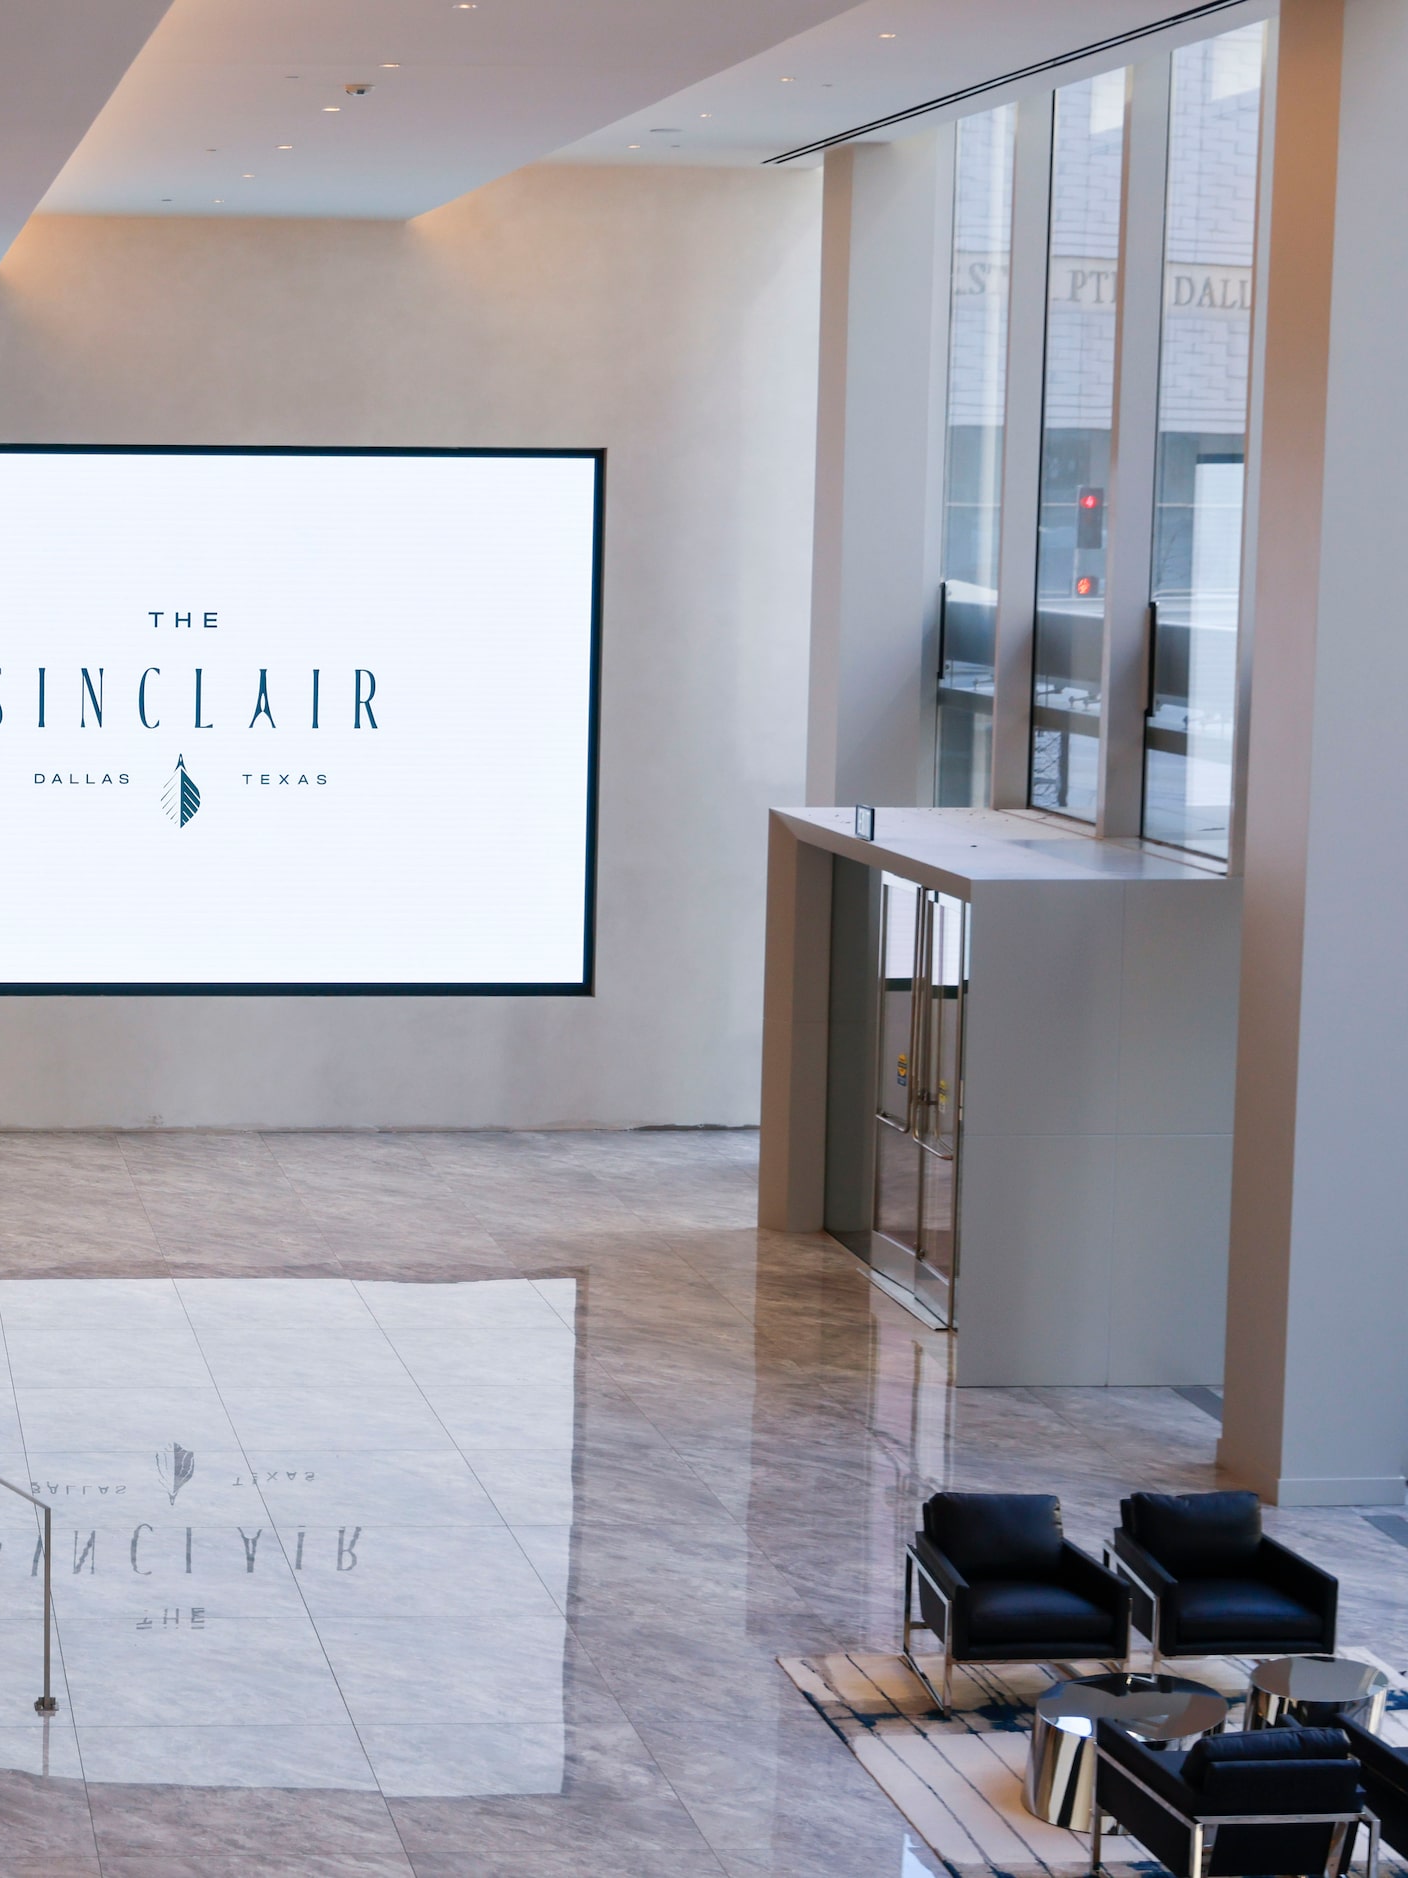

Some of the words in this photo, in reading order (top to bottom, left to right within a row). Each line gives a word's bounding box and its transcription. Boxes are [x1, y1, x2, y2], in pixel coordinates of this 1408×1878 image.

[148, 611, 219, 629] THE
[34, 773, 131, 785] DALLAS
[242, 774, 328, 786] TEXAS
